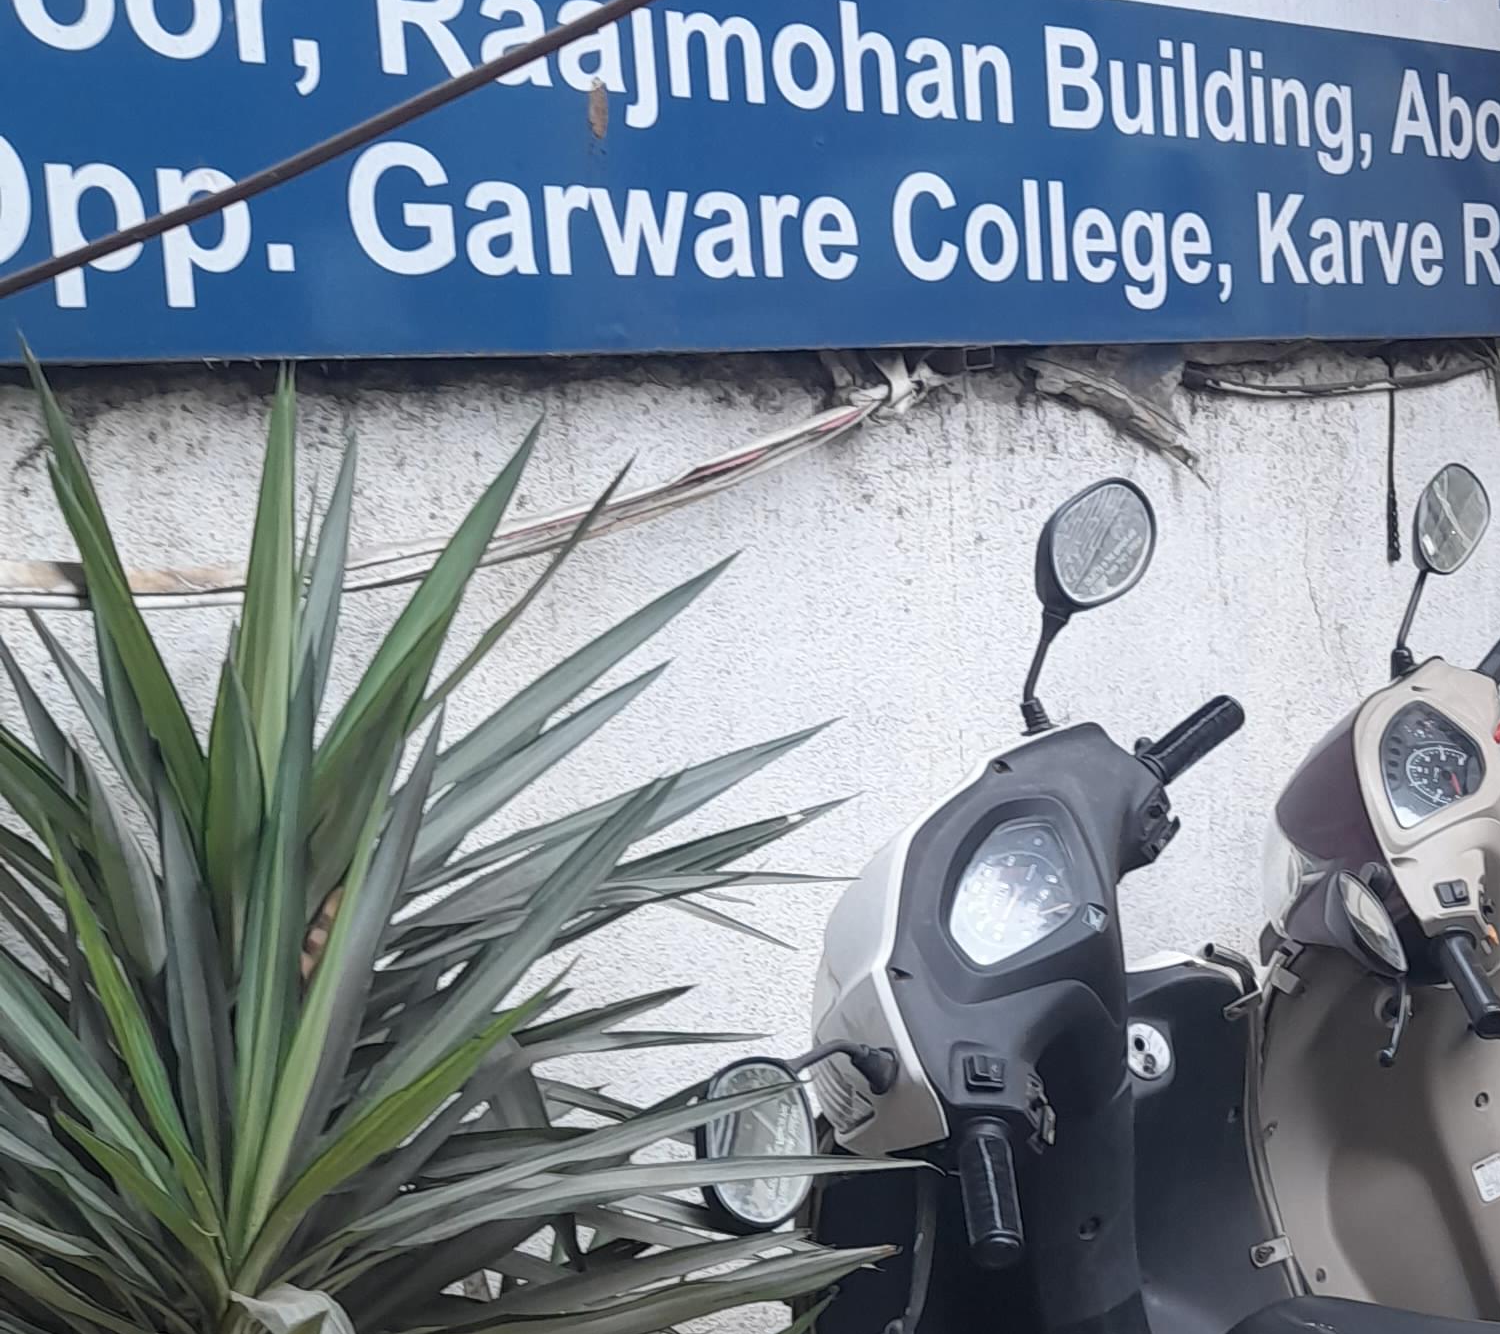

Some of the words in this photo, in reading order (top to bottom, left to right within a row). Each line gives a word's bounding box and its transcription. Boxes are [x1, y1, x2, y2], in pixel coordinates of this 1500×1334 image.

[1042, 25, 1374, 175] Building,
[348, 141, 860, 282] Garware
[891, 171, 1233, 311] College,
[1256, 191, 1444, 288] Karve
